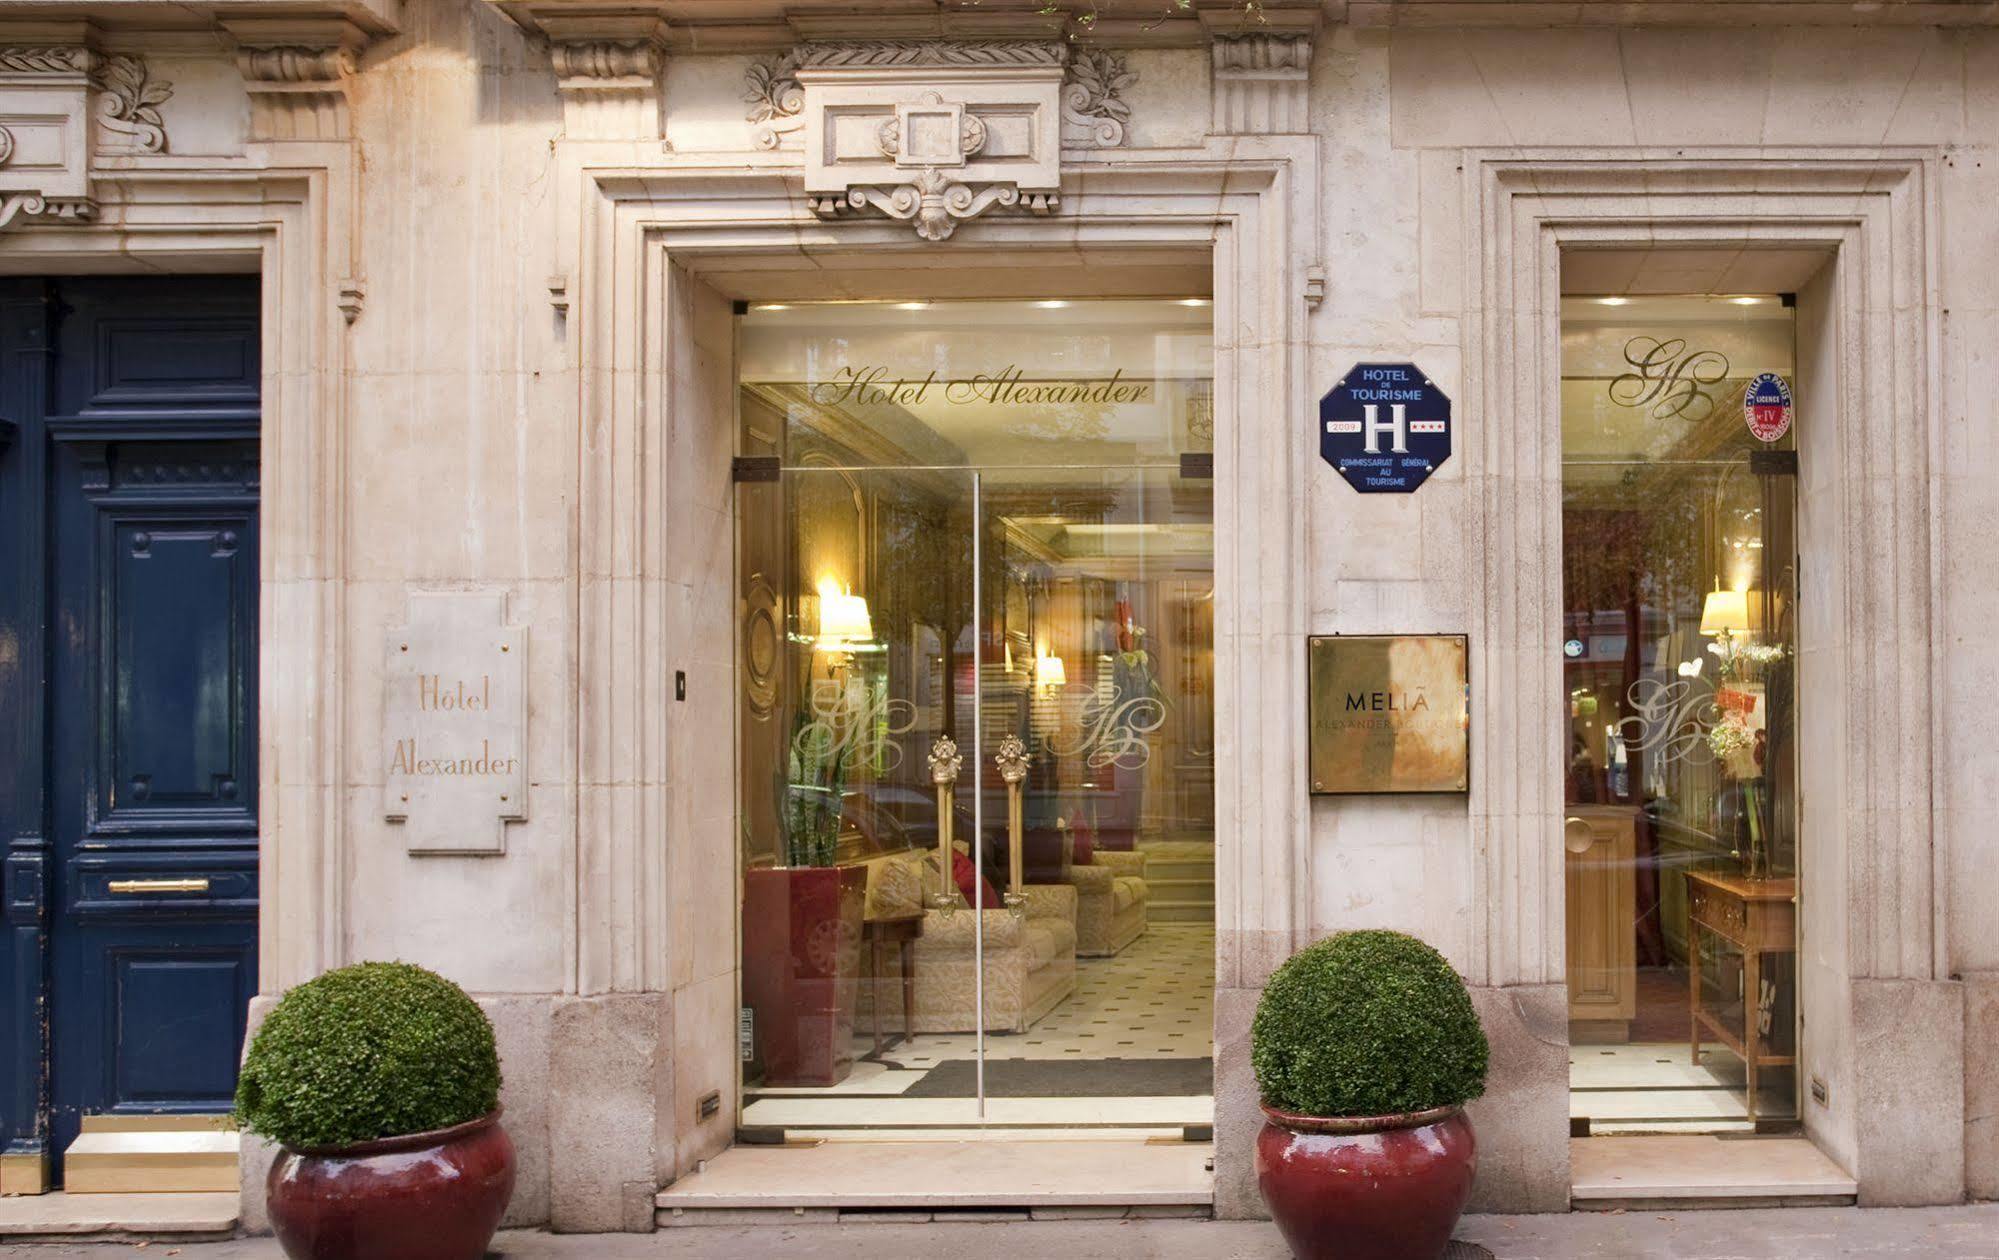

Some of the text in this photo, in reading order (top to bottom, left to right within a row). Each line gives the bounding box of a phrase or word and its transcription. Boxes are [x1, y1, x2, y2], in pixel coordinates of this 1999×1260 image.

[1363, 370, 1410, 381] HOTEL
[813, 363, 1149, 406] Hotel Alexander
[1747, 377, 1763, 399] VILLE
[1772, 376, 1790, 400] PARIS
[1351, 389, 1422, 400] TOURISME
[1332, 423, 1356, 431] 2009
[1362, 404, 1410, 454] H
[1340, 458, 1393, 467] COMMISSARIAT
[1366, 477, 1406, 486] TOURISME
[1315, 719, 1394, 729] ALEXANDER
[390, 737, 519, 776] Alexander
